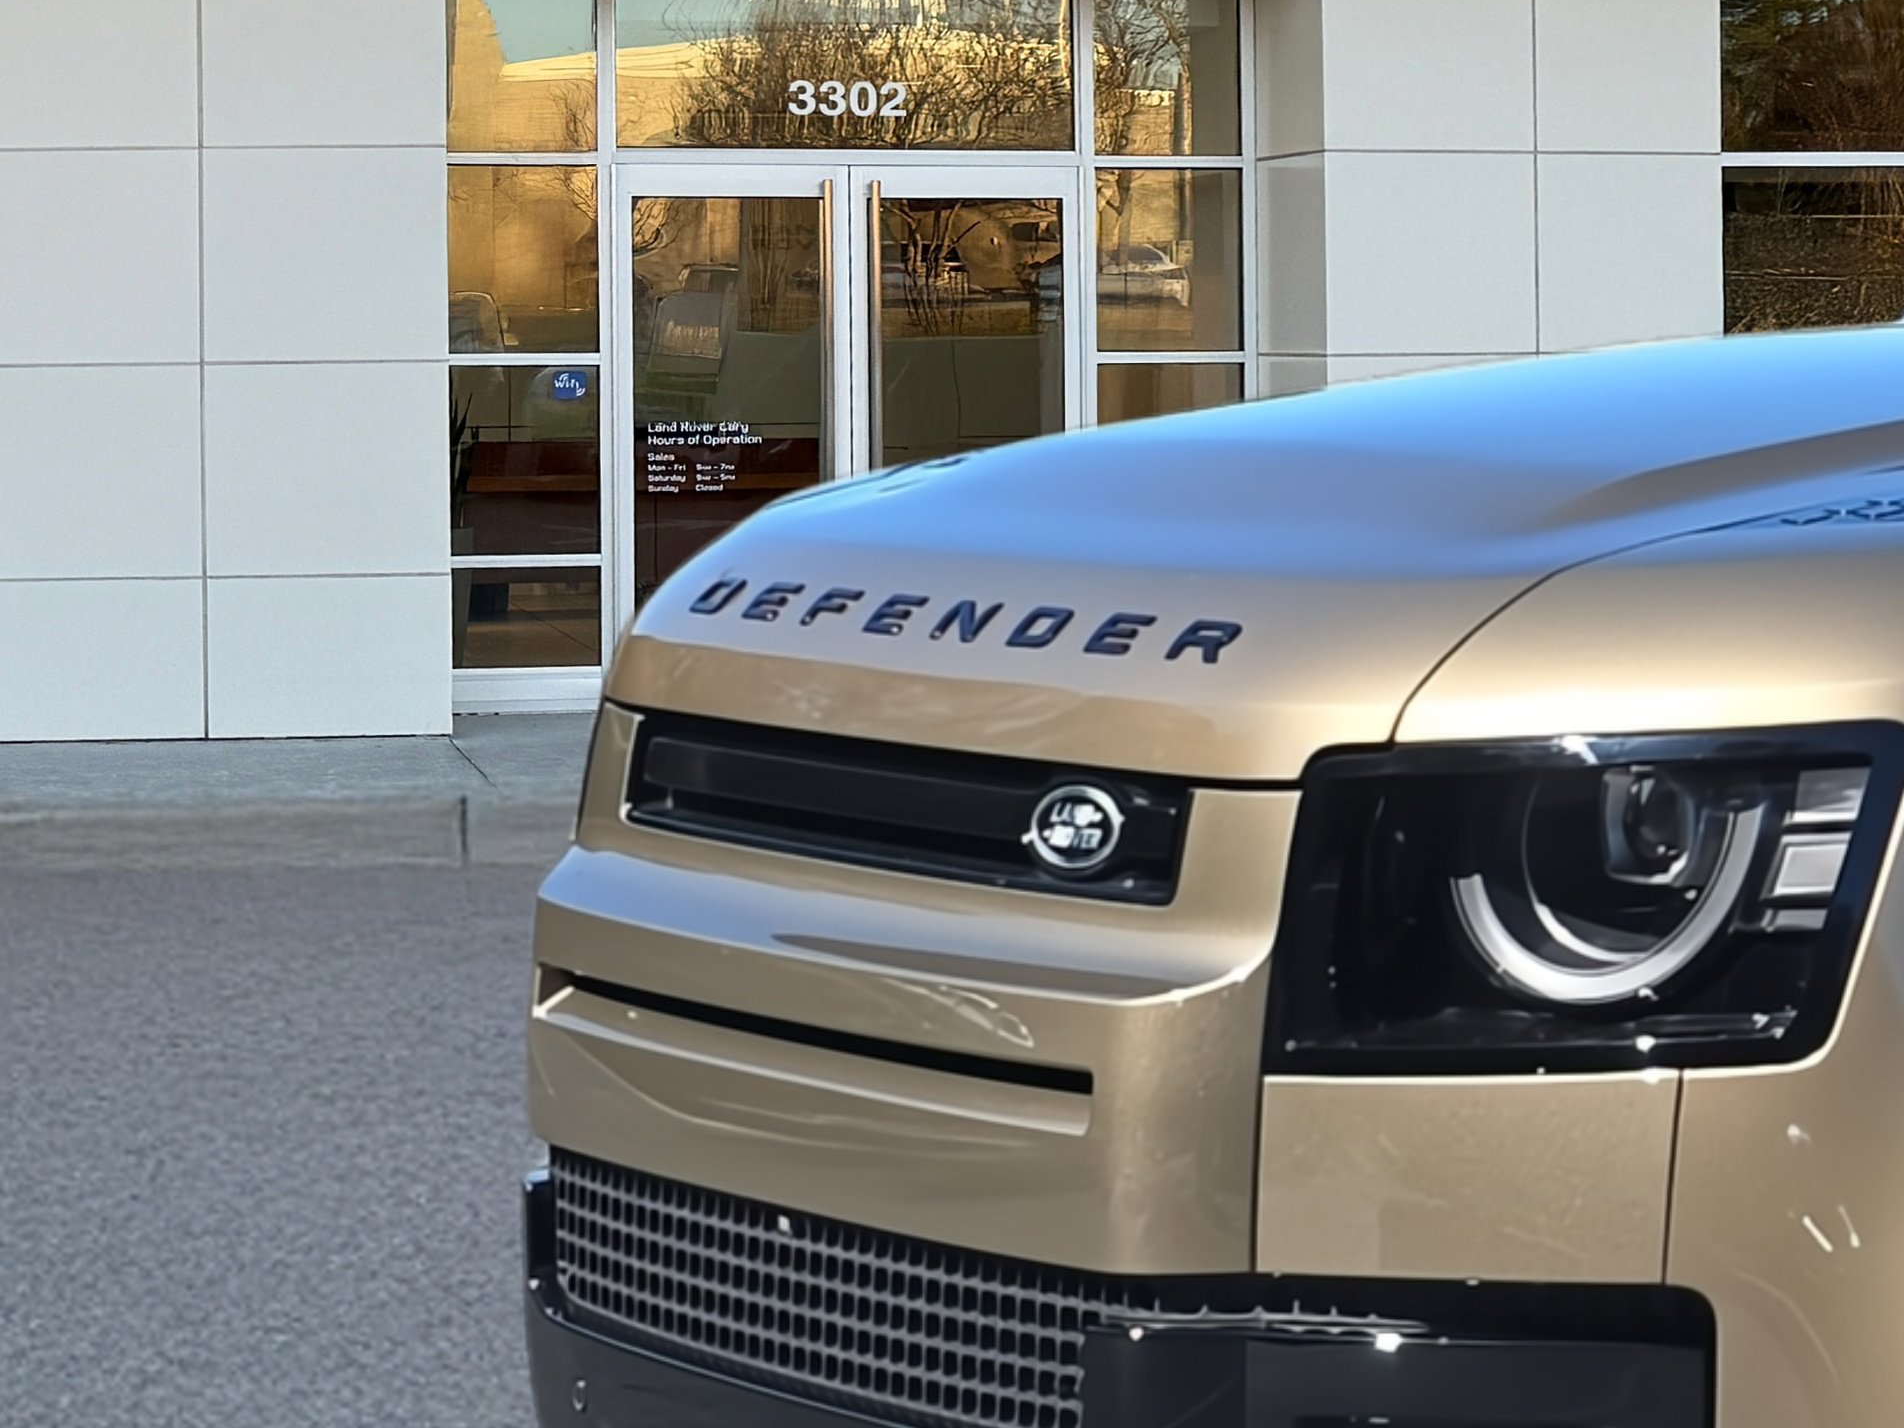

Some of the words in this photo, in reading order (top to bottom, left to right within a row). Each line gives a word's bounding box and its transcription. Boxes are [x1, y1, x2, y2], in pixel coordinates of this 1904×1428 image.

[787, 79, 908, 117] 3302
[647, 421, 677, 433] Land
[647, 435, 685, 445] Hours
[687, 434, 700, 445] of
[703, 434, 763, 447] Operation
[687, 575, 1244, 665] DEFENDER
